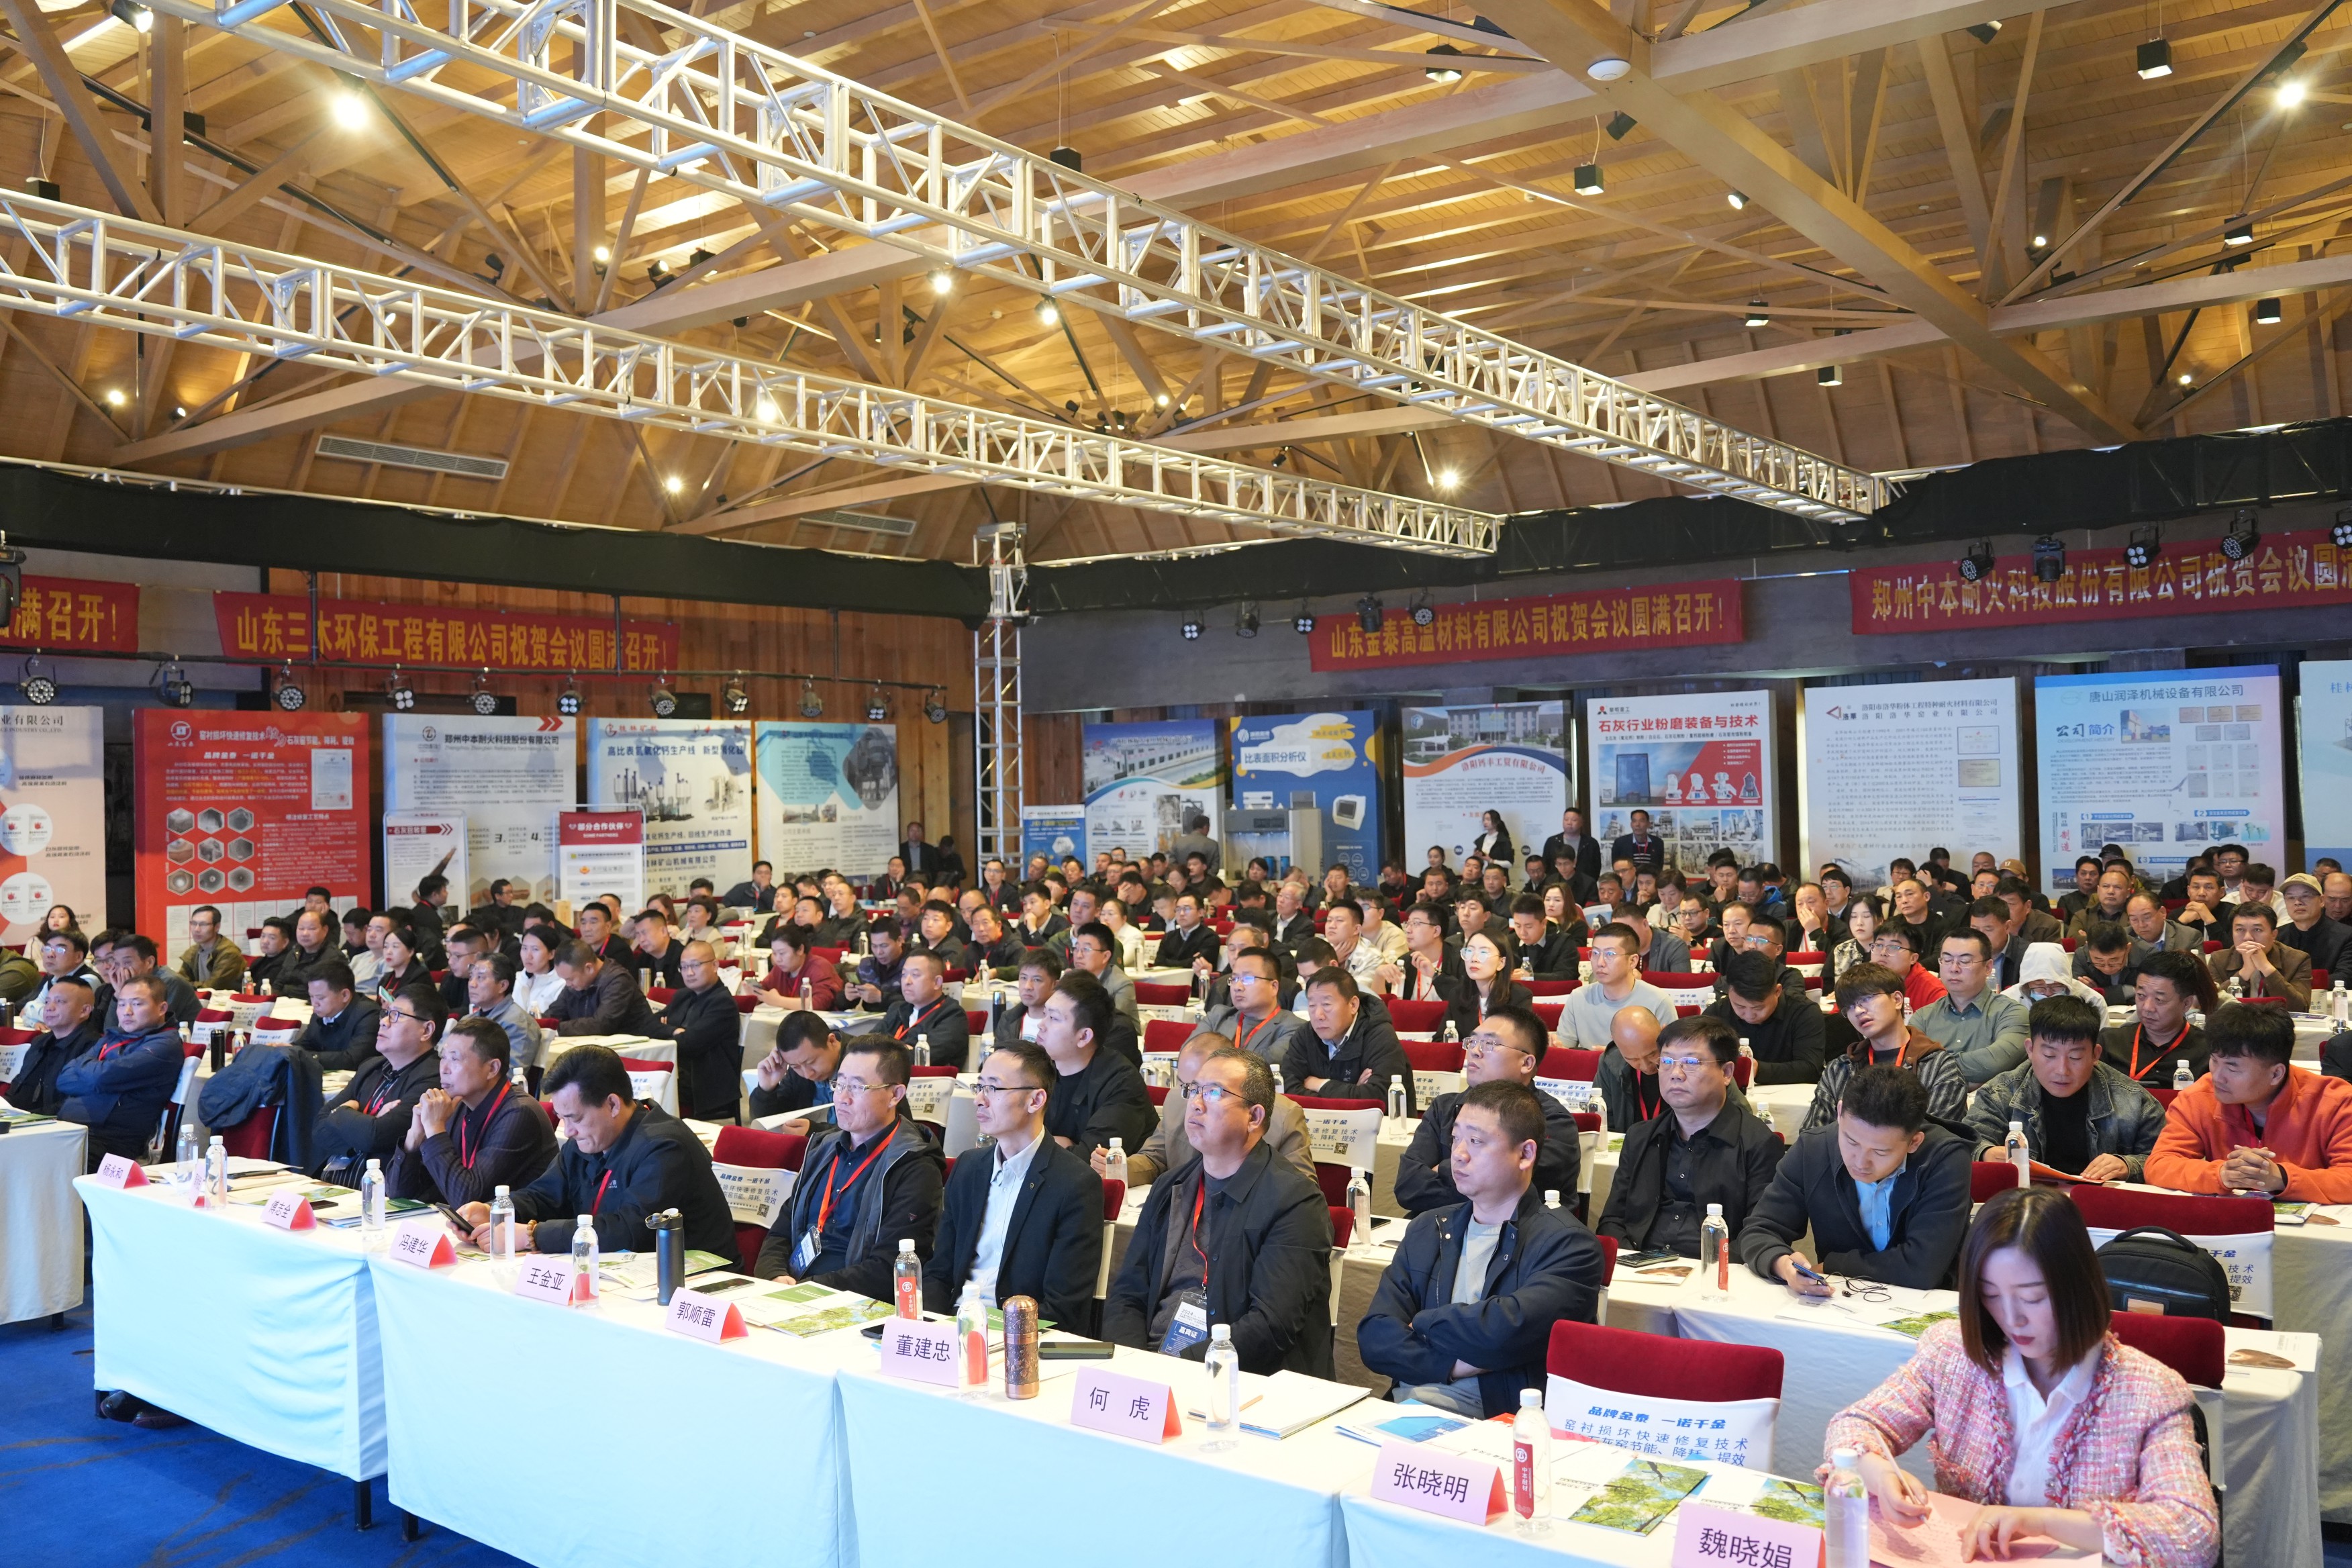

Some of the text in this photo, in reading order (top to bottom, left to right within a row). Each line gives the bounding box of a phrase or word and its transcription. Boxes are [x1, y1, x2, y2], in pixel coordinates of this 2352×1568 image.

[0, 587, 116, 642] 满召开！
[2089, 685, 2243, 702] 唐山润泽机械设备有限公司
[1599, 714, 1759, 732] 石灰行业粉磨装备与技术
[444, 734, 559, 744] 郑州中本耐火科技股份有限公司
[1244, 752, 1306, 764] 比表面积分析仪
[577, 822, 624, 831] 部分合作伙伴
[720, 1184, 779, 1196] 损坏快速修复技术
[398, 1234, 429, 1256] 冯建华
[526, 1267, 565, 1291] 王金亚
[2227, 1264, 2254, 1273] 技术
[2229, 1274, 2253, 1284] 提效
[677, 1300, 716, 1328] 郭顺雷
[895, 1334, 950, 1362] 董建忠
[1587, 1406, 1726, 1429] 品牌金泰 一诺千金
[1565, 1418, 1749, 1451] 窑衬损坏快速修复技术
[1393, 1463, 1469, 1503] 张晓明
[1698, 1528, 1792, 1568] 魏晓娟
